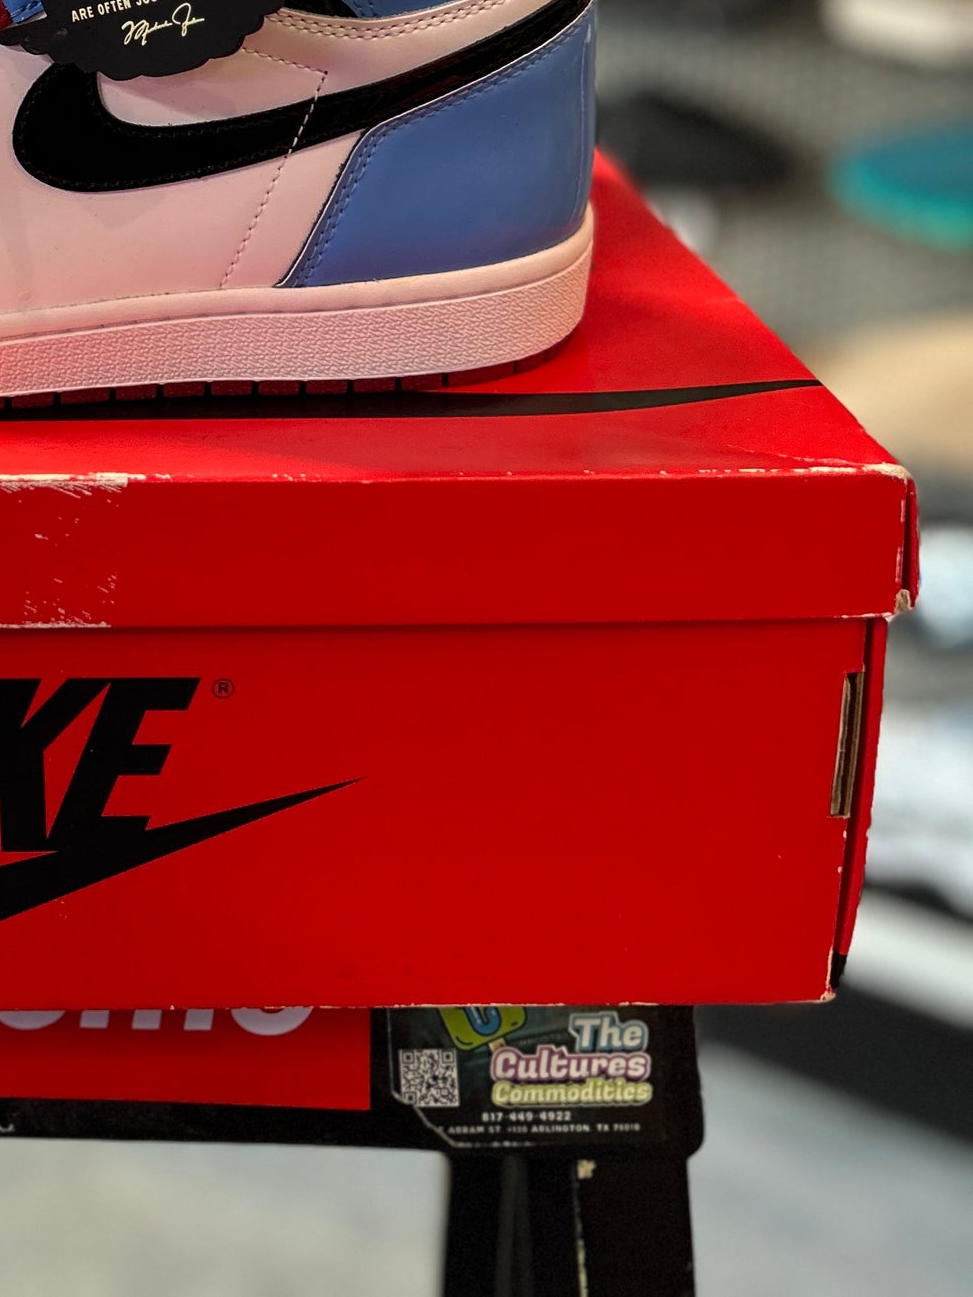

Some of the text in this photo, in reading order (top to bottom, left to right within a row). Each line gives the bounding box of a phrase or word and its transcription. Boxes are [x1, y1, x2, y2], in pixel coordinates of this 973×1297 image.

[71, 5, 95, 23] ARE
[571, 1013, 646, 1050] The
[491, 1046, 649, 1081] Cultures
[493, 1078, 651, 1105] Commodities
[531, 1123, 590, 1134] ARLINGTON
[596, 1122, 610, 1132] TX
